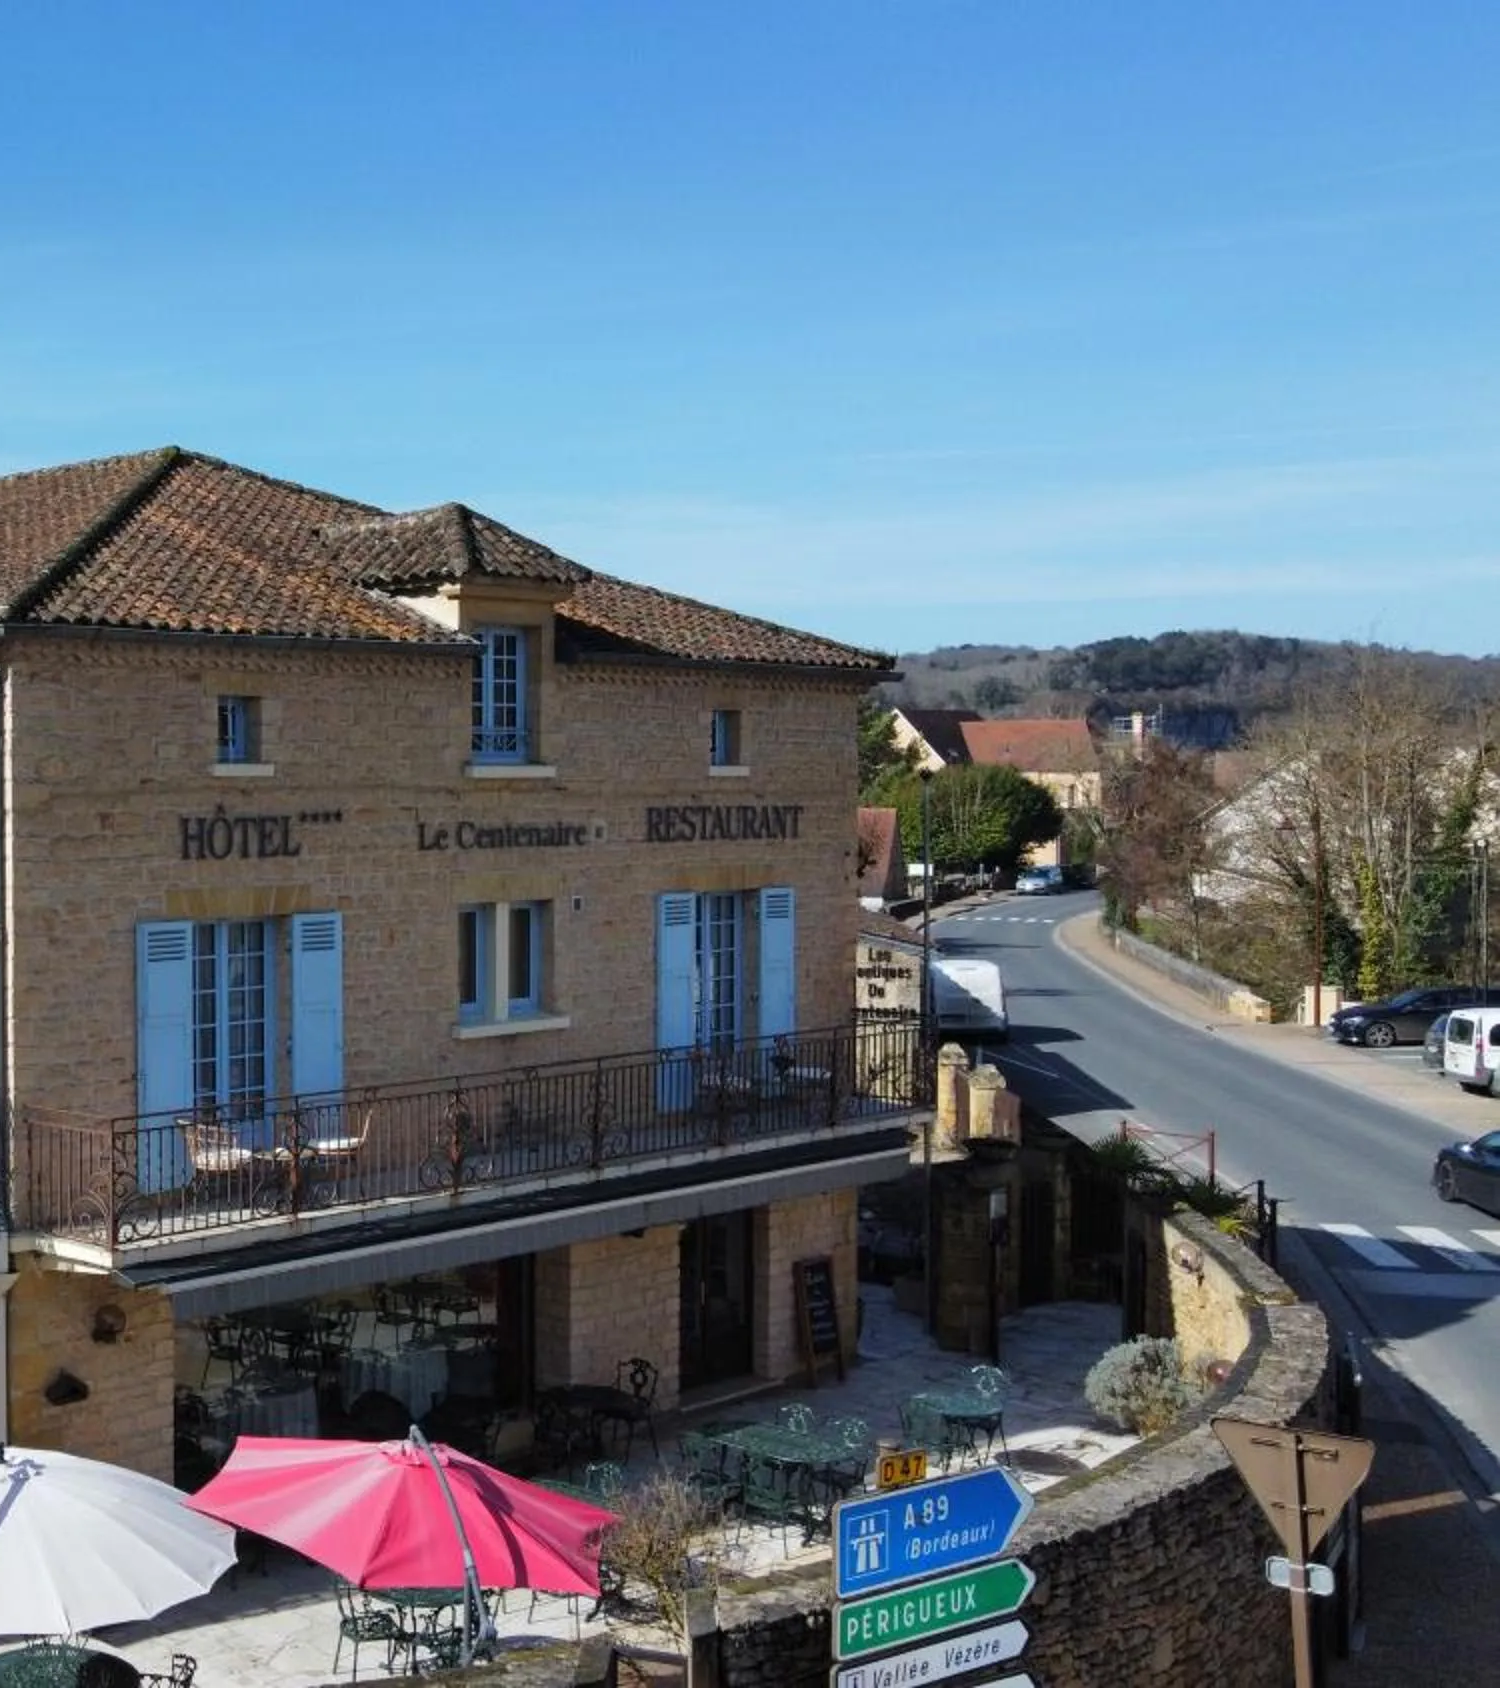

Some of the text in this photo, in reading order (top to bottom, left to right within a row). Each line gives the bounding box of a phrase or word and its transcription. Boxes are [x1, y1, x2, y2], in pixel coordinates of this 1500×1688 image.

[181, 803, 301, 860] HÔTEL
[417, 820, 587, 851] Le Centenaire
[645, 805, 804, 843] RESTAURANT
[900, 1455, 923, 1477] 47
[904, 1495, 949, 1530] A 89
[905, 1519, 996, 1561] (Bordeaux)
[847, 1583, 977, 1644] PÉRIGUEUX
[873, 1637, 1001, 1688] Vallée Vézère
